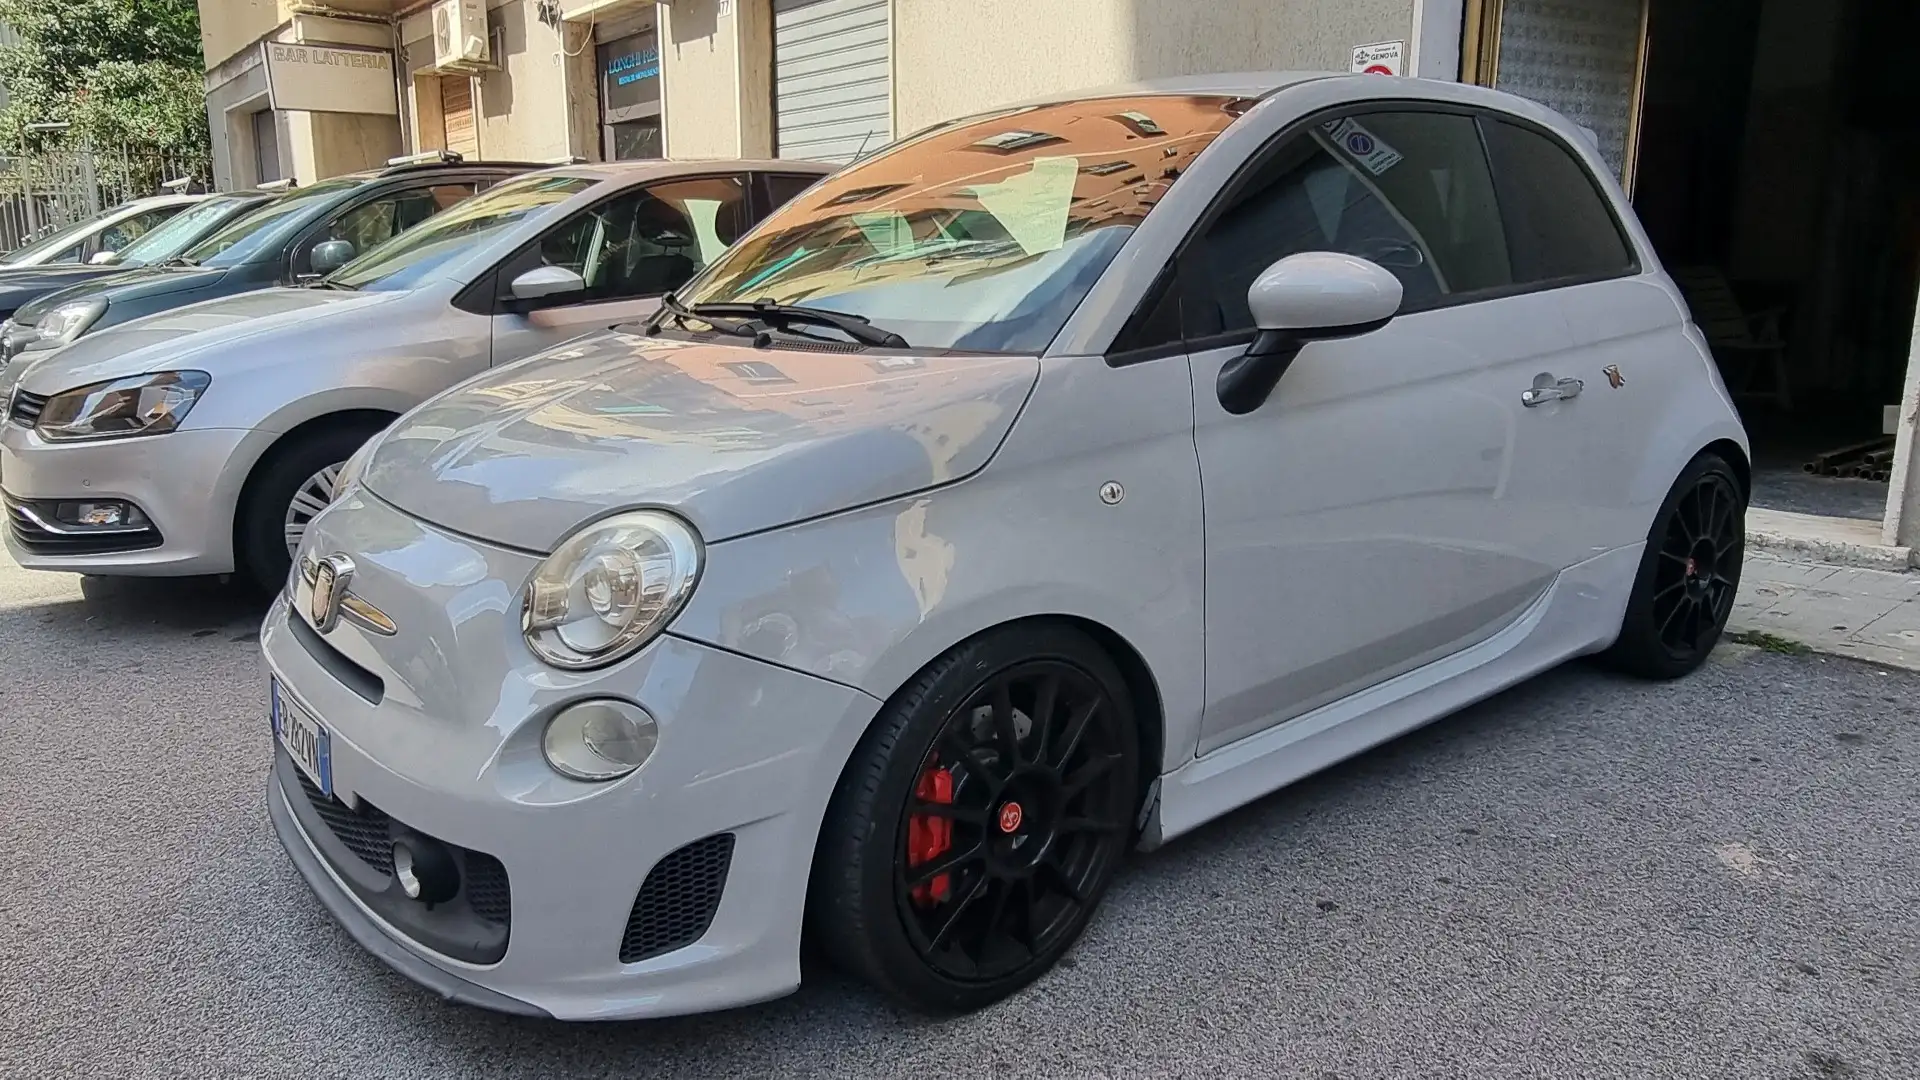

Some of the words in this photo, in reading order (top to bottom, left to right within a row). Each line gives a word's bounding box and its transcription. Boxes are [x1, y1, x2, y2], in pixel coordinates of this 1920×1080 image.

[273, 46, 308, 63] BAR
[312, 49, 388, 70] LATTERIA
[608, 51, 641, 74] LONGHI
[1371, 51, 1398, 61] GENOVA
